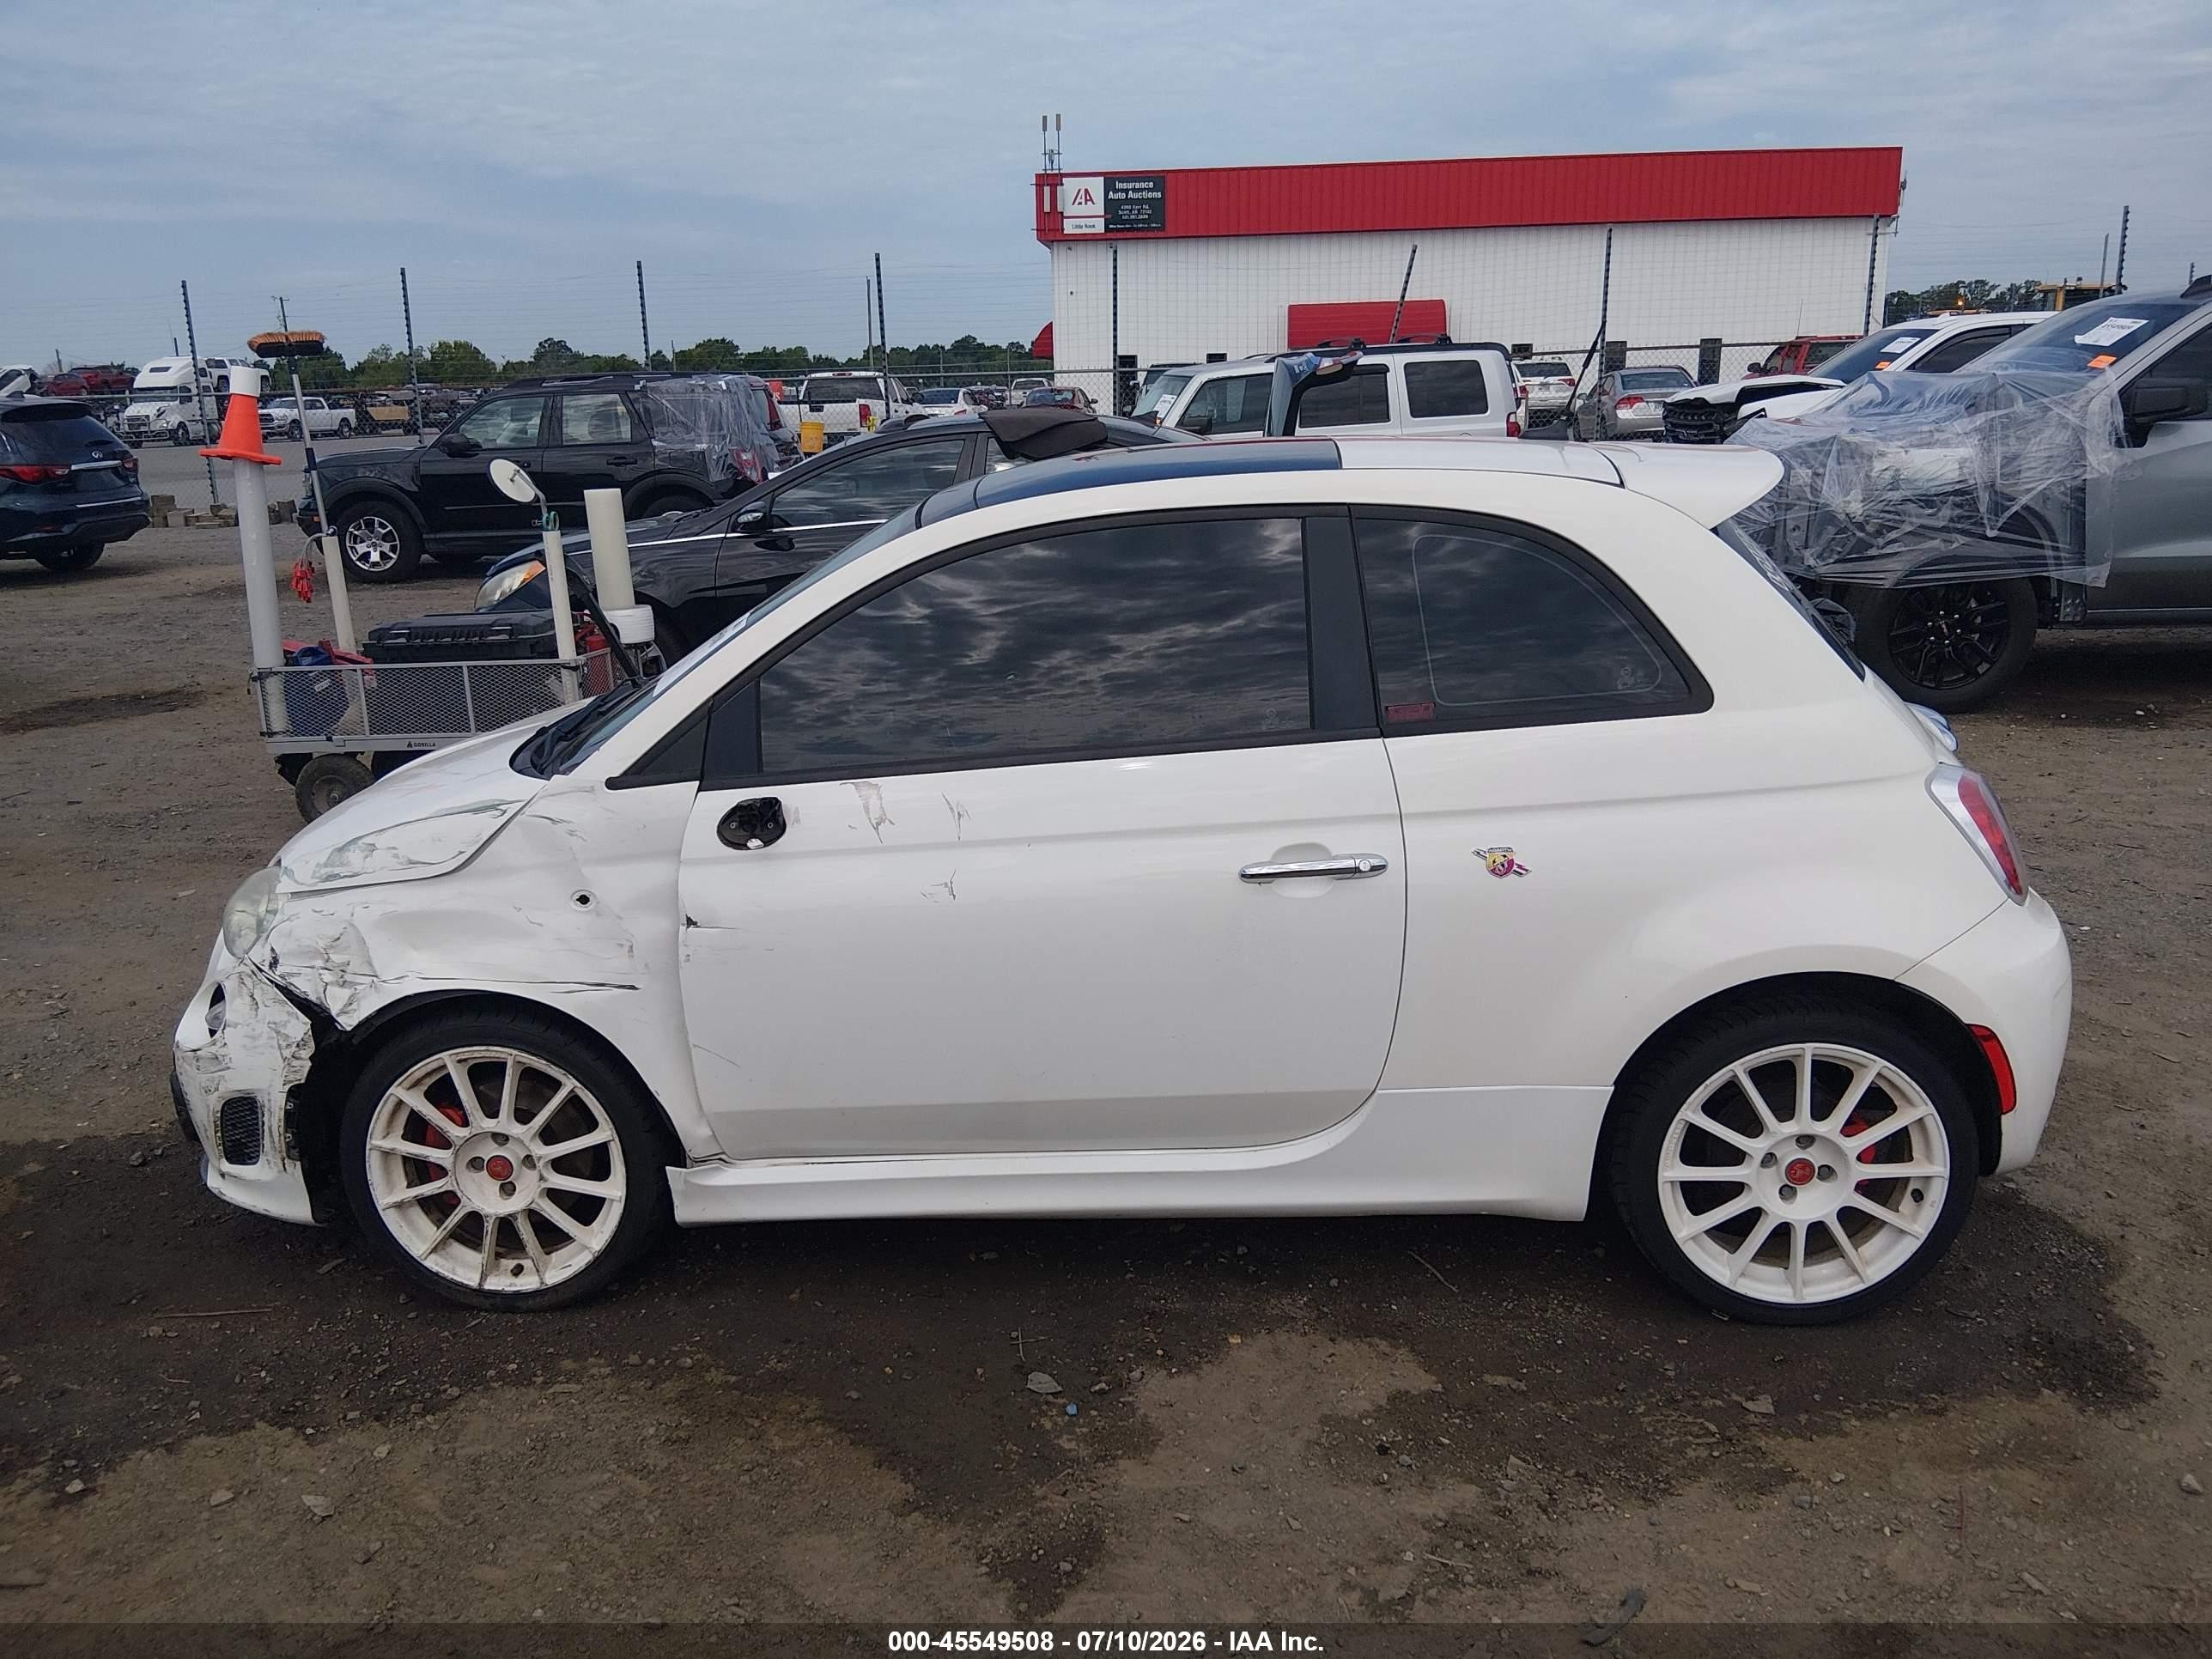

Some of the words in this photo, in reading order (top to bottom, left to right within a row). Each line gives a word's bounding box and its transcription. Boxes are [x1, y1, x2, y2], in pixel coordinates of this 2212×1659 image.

[1115, 180, 1154, 189] Insurance
[1108, 191, 1126, 199] Auto
[1127, 190, 1162, 199] Auctions
